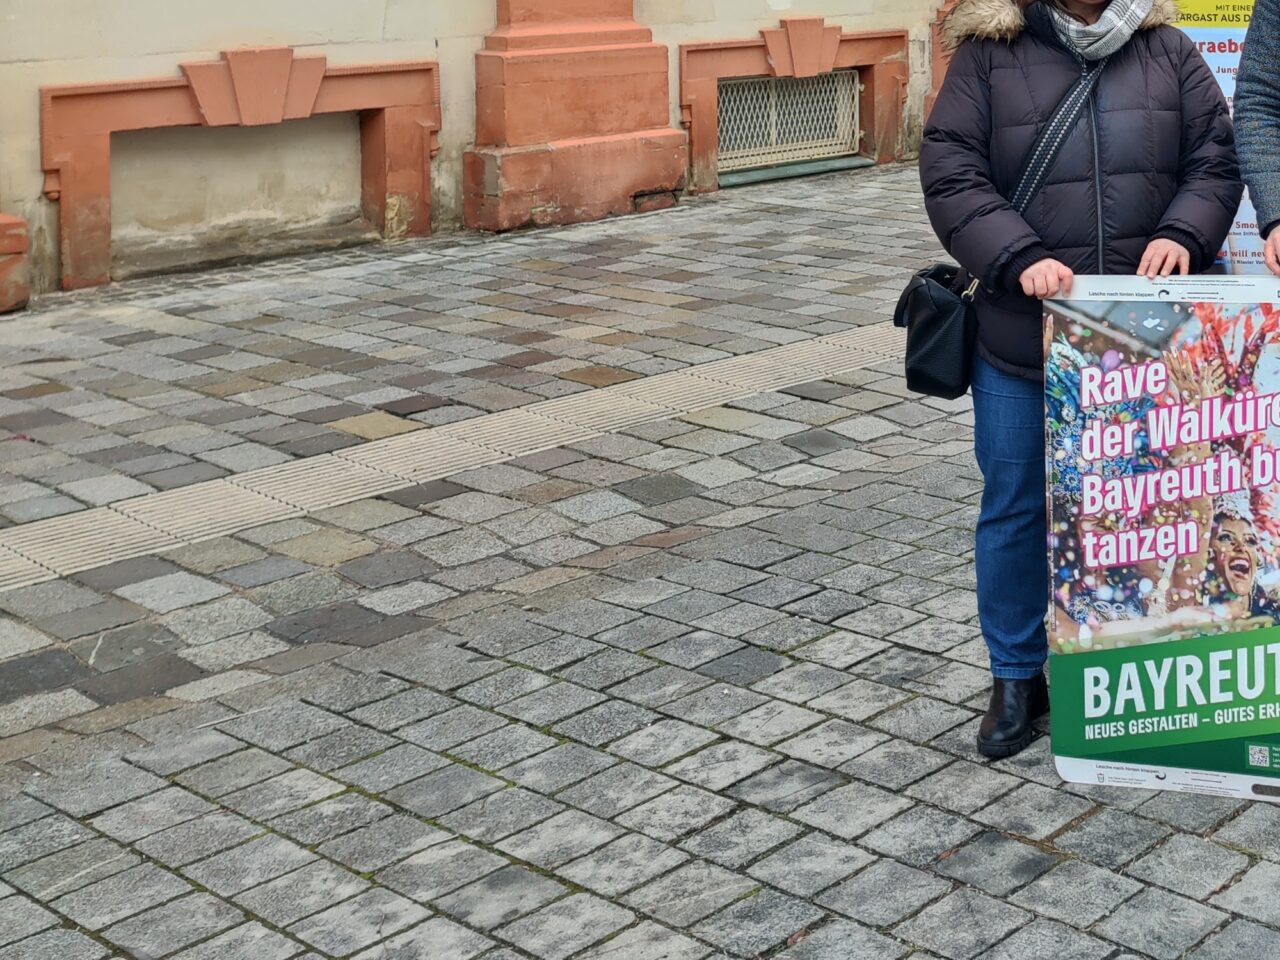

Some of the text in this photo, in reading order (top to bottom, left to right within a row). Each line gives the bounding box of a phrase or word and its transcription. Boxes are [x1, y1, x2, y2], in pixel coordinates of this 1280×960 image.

[1220, 14, 1241, 22] AUS
[1081, 361, 1167, 407] Rave
[1082, 417, 1139, 461] der
[1082, 449, 1243, 519] Bayreuth
[1082, 520, 1200, 569] tanzen
[1085, 721, 1125, 740] NEUES
[1129, 713, 1198, 735] GESTALTEN
[1214, 706, 1255, 725] GUTES
